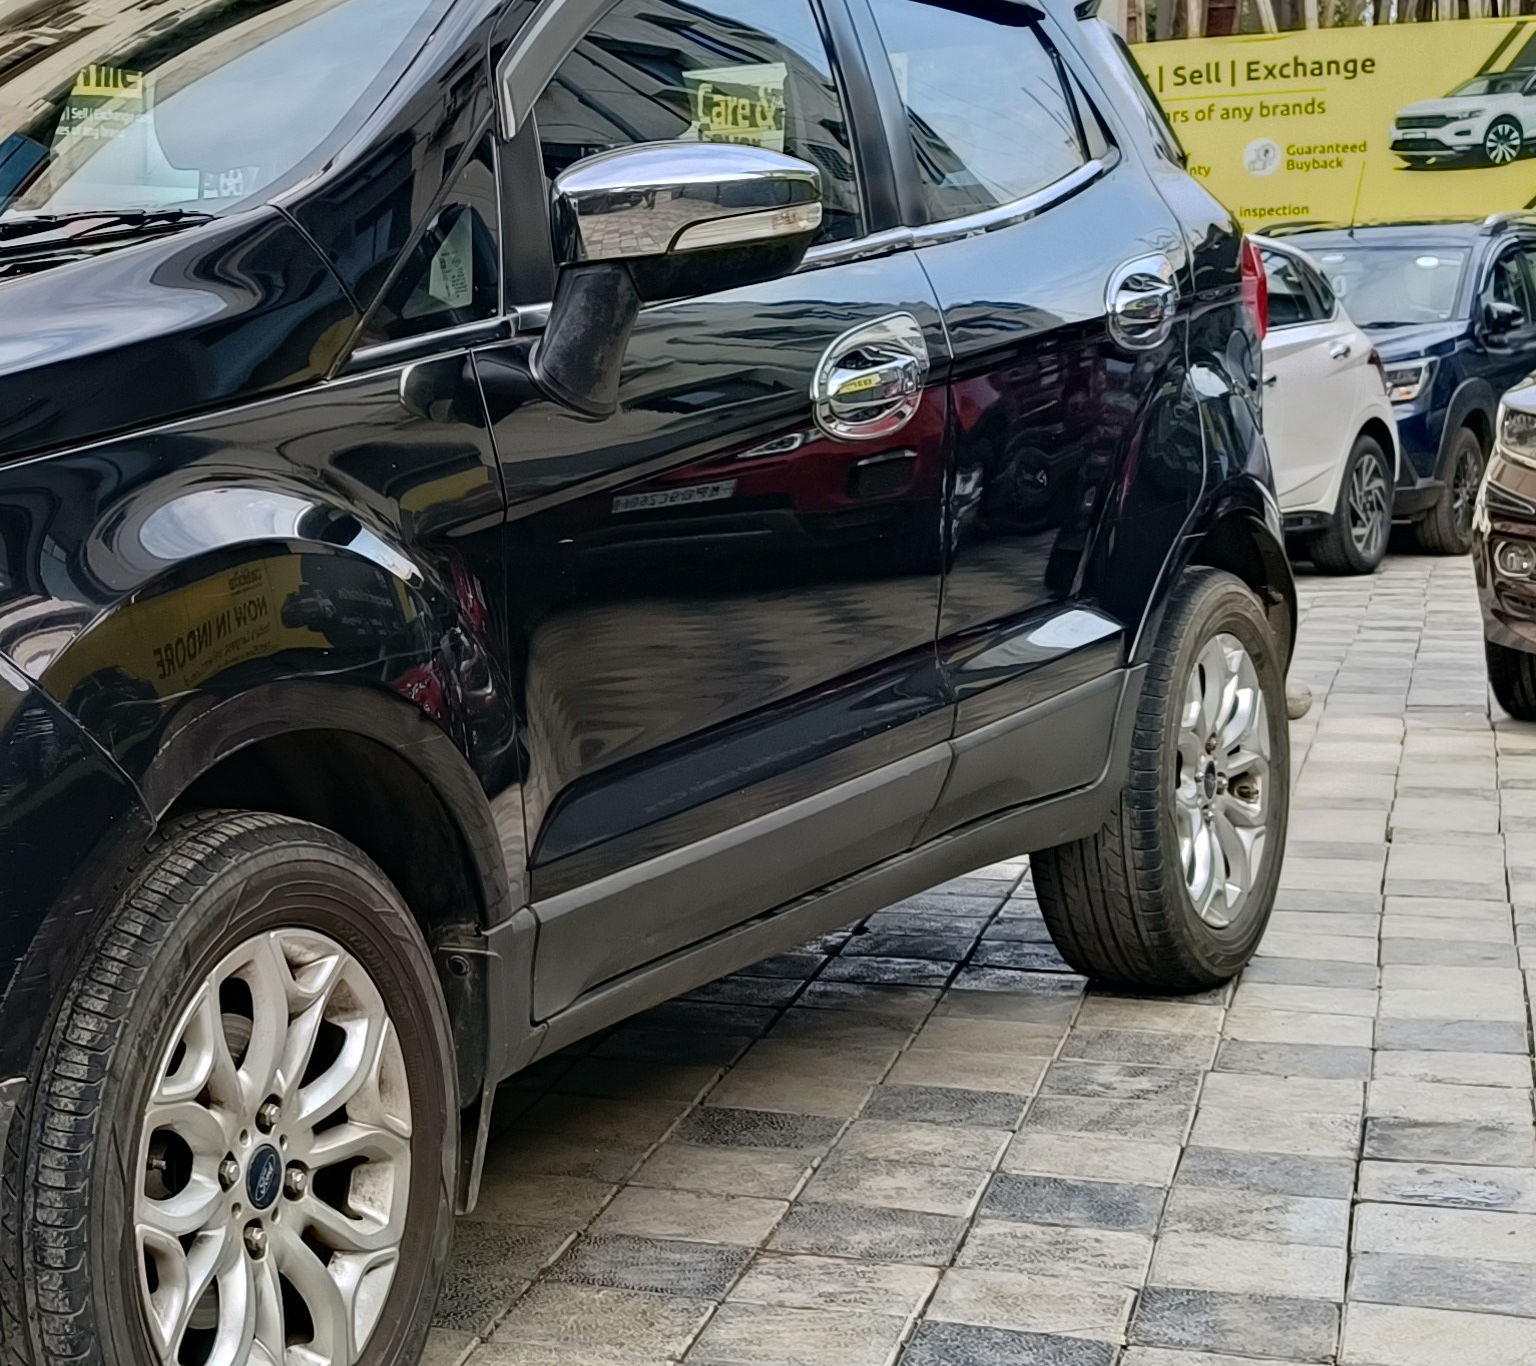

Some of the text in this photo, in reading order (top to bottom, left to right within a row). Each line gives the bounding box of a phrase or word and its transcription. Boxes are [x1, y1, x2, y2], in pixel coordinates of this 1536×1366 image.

[1172, 60, 1222, 86] Sell
[1245, 55, 1376, 81] Exchange
[697, 82, 751, 128] Care
[1194, 103, 1216, 122] of
[1219, 106, 1254, 123] any
[1259, 97, 1327, 118] brands
[1286, 140, 1368, 156] Guaranteed
[1286, 157, 1344, 171] Buyback
[1239, 204, 1310, 219] inspection
